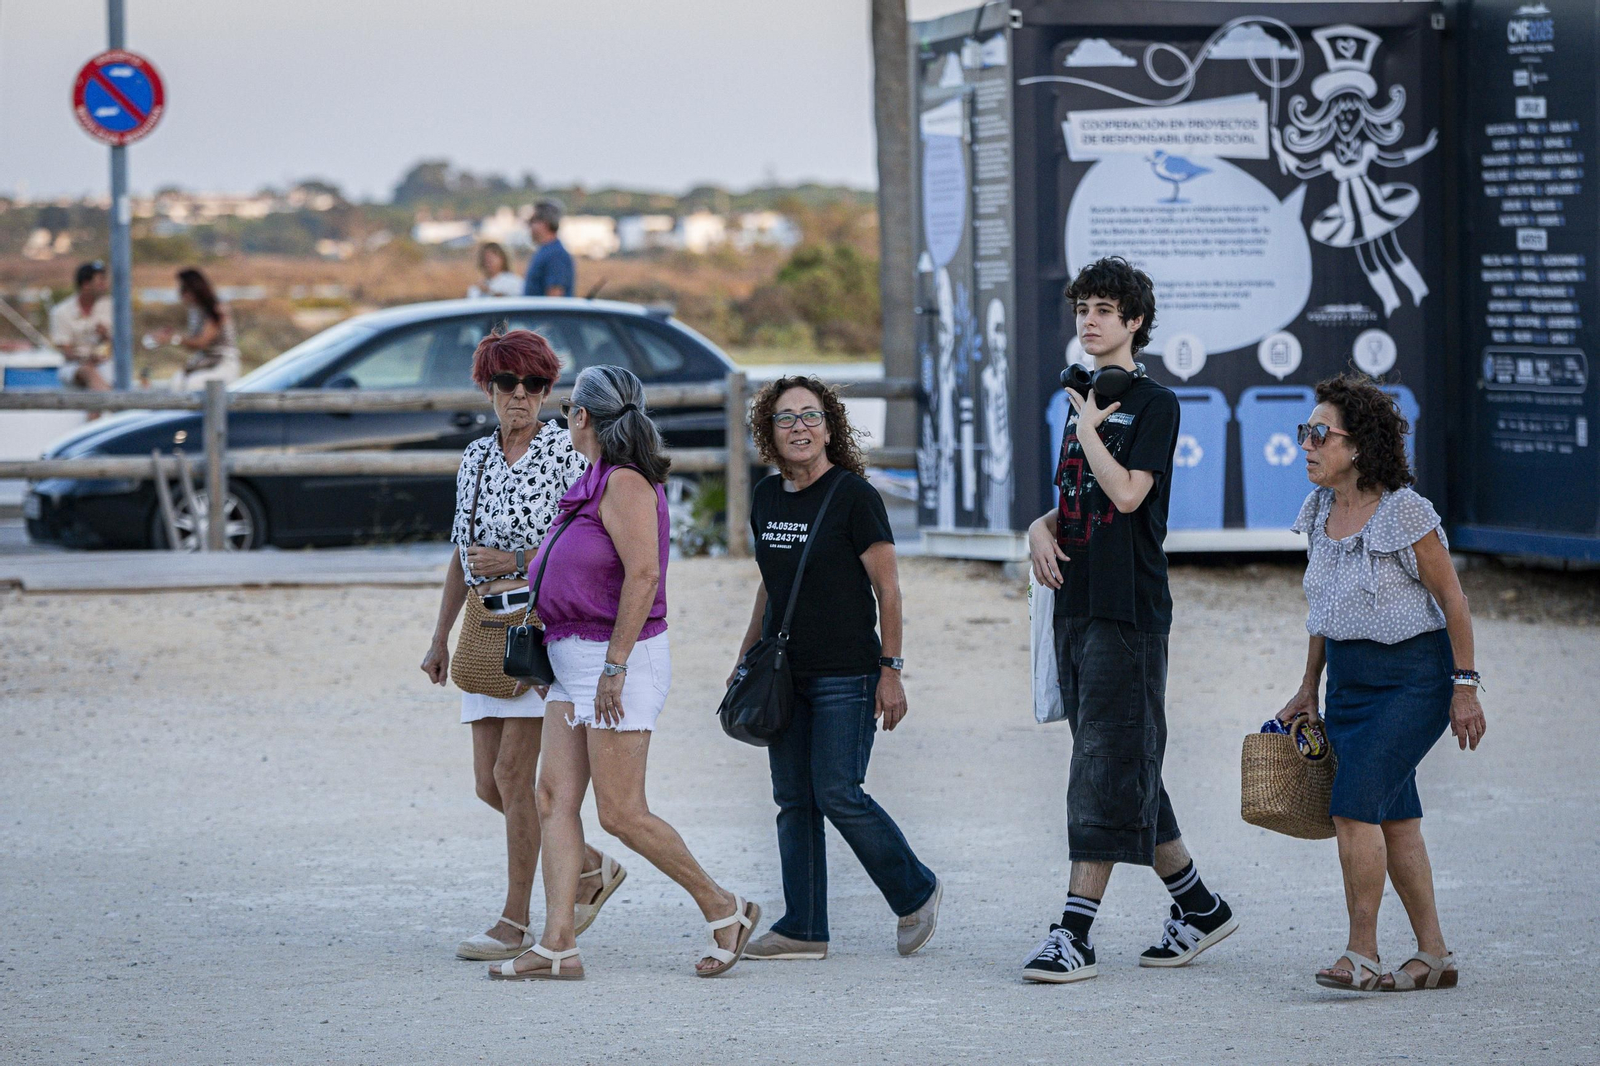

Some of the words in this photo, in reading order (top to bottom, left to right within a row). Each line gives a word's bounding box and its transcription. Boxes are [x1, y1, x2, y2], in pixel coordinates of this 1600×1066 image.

[1169, 119, 1186, 130] EN
[1188, 119, 1260, 131] PROYECTOS
[1082, 134, 1096, 145] DE
[1213, 134, 1256, 145] SOCIAL
